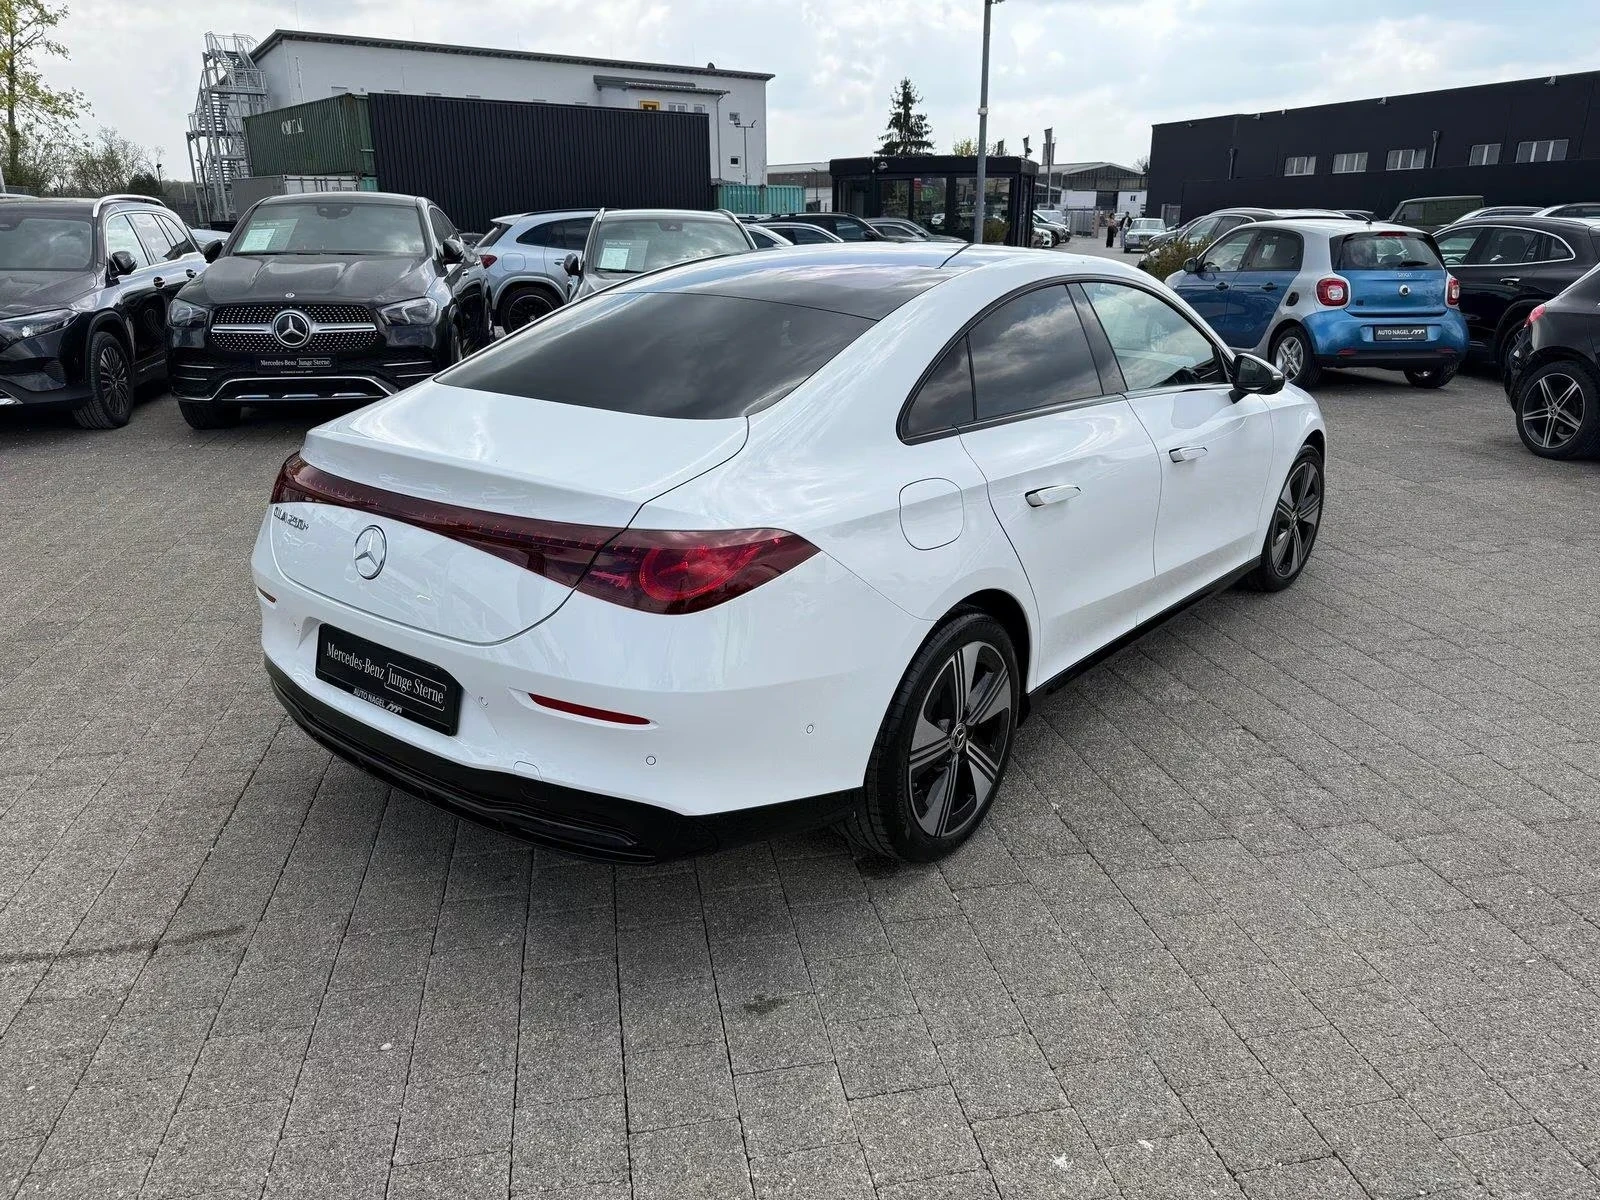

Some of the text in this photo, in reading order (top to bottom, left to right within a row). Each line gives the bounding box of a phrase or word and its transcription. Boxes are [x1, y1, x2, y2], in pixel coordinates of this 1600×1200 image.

[326, 641, 445, 704] Mercedes-Benz Junge Sterne
[352, 687, 386, 708] AUTO NAGEL
